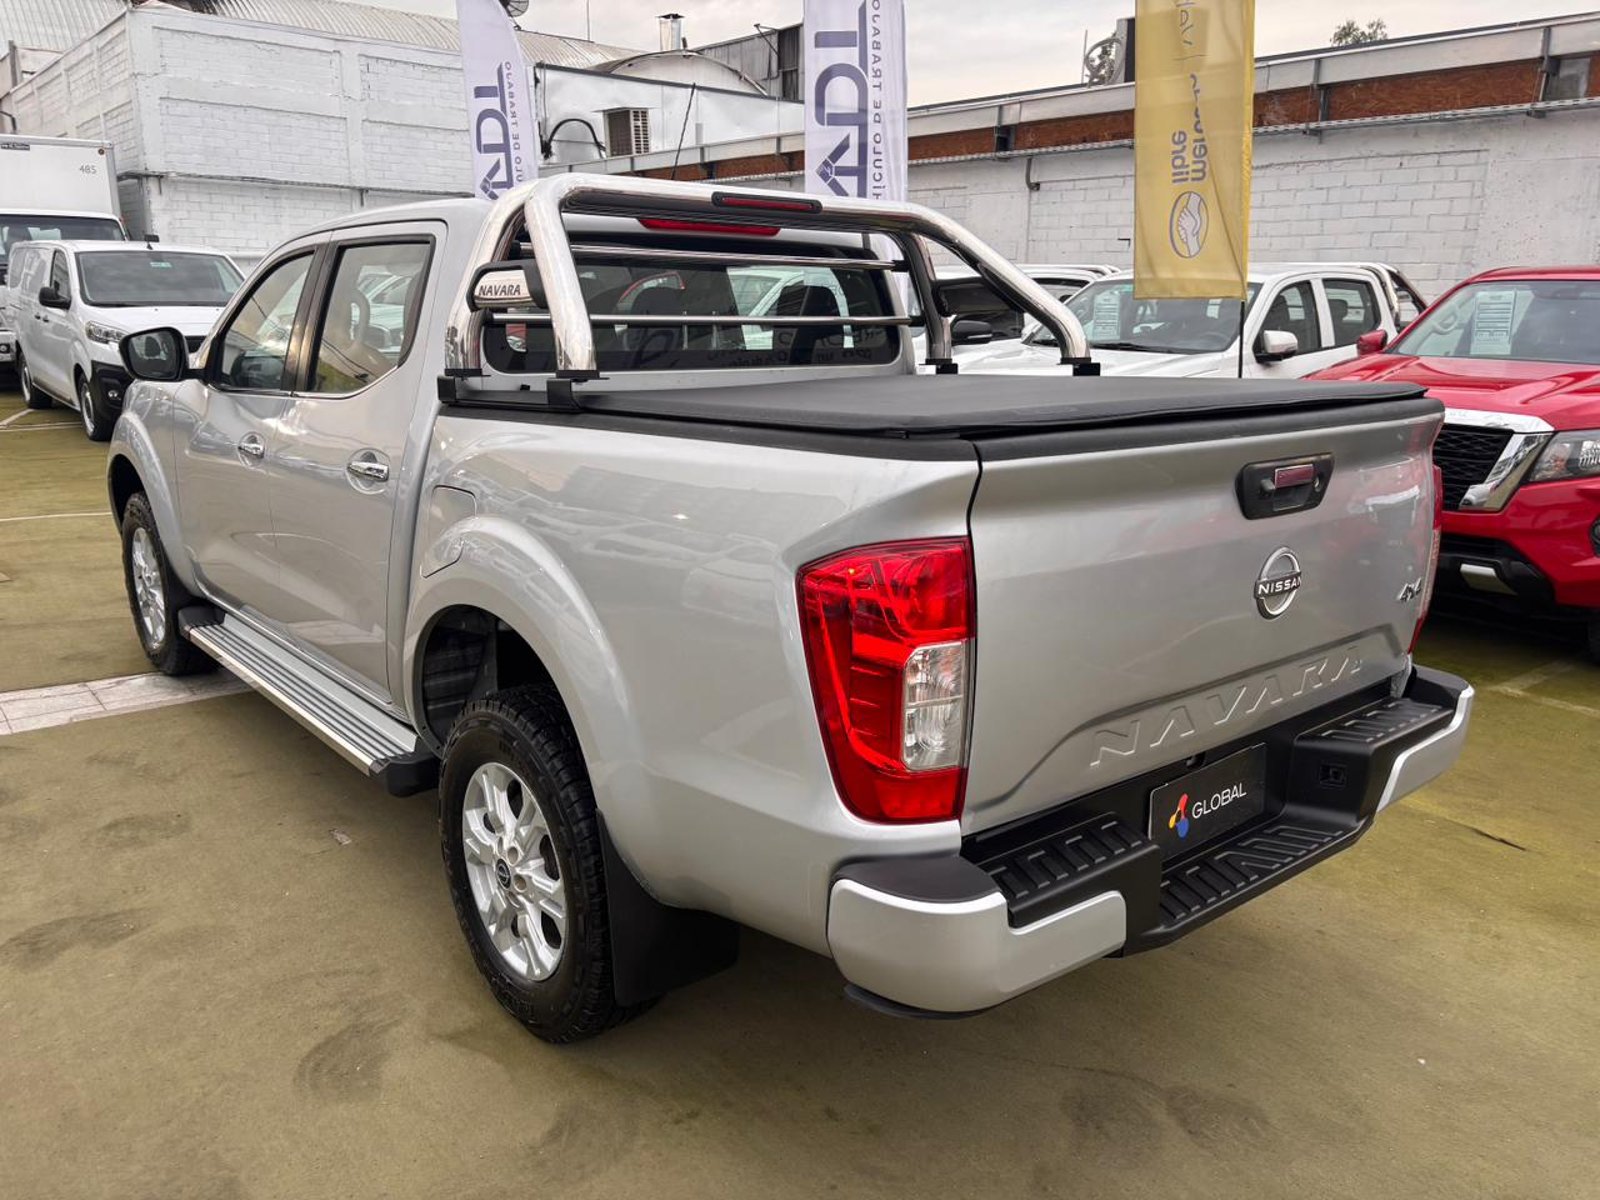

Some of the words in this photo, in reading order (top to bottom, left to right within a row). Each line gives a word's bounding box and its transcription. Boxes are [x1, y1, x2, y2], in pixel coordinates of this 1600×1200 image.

[478, 284, 521, 297] NAVARA
[1090, 645, 1362, 767] NAVARA
[1191, 782, 1248, 819] GLOBAL
